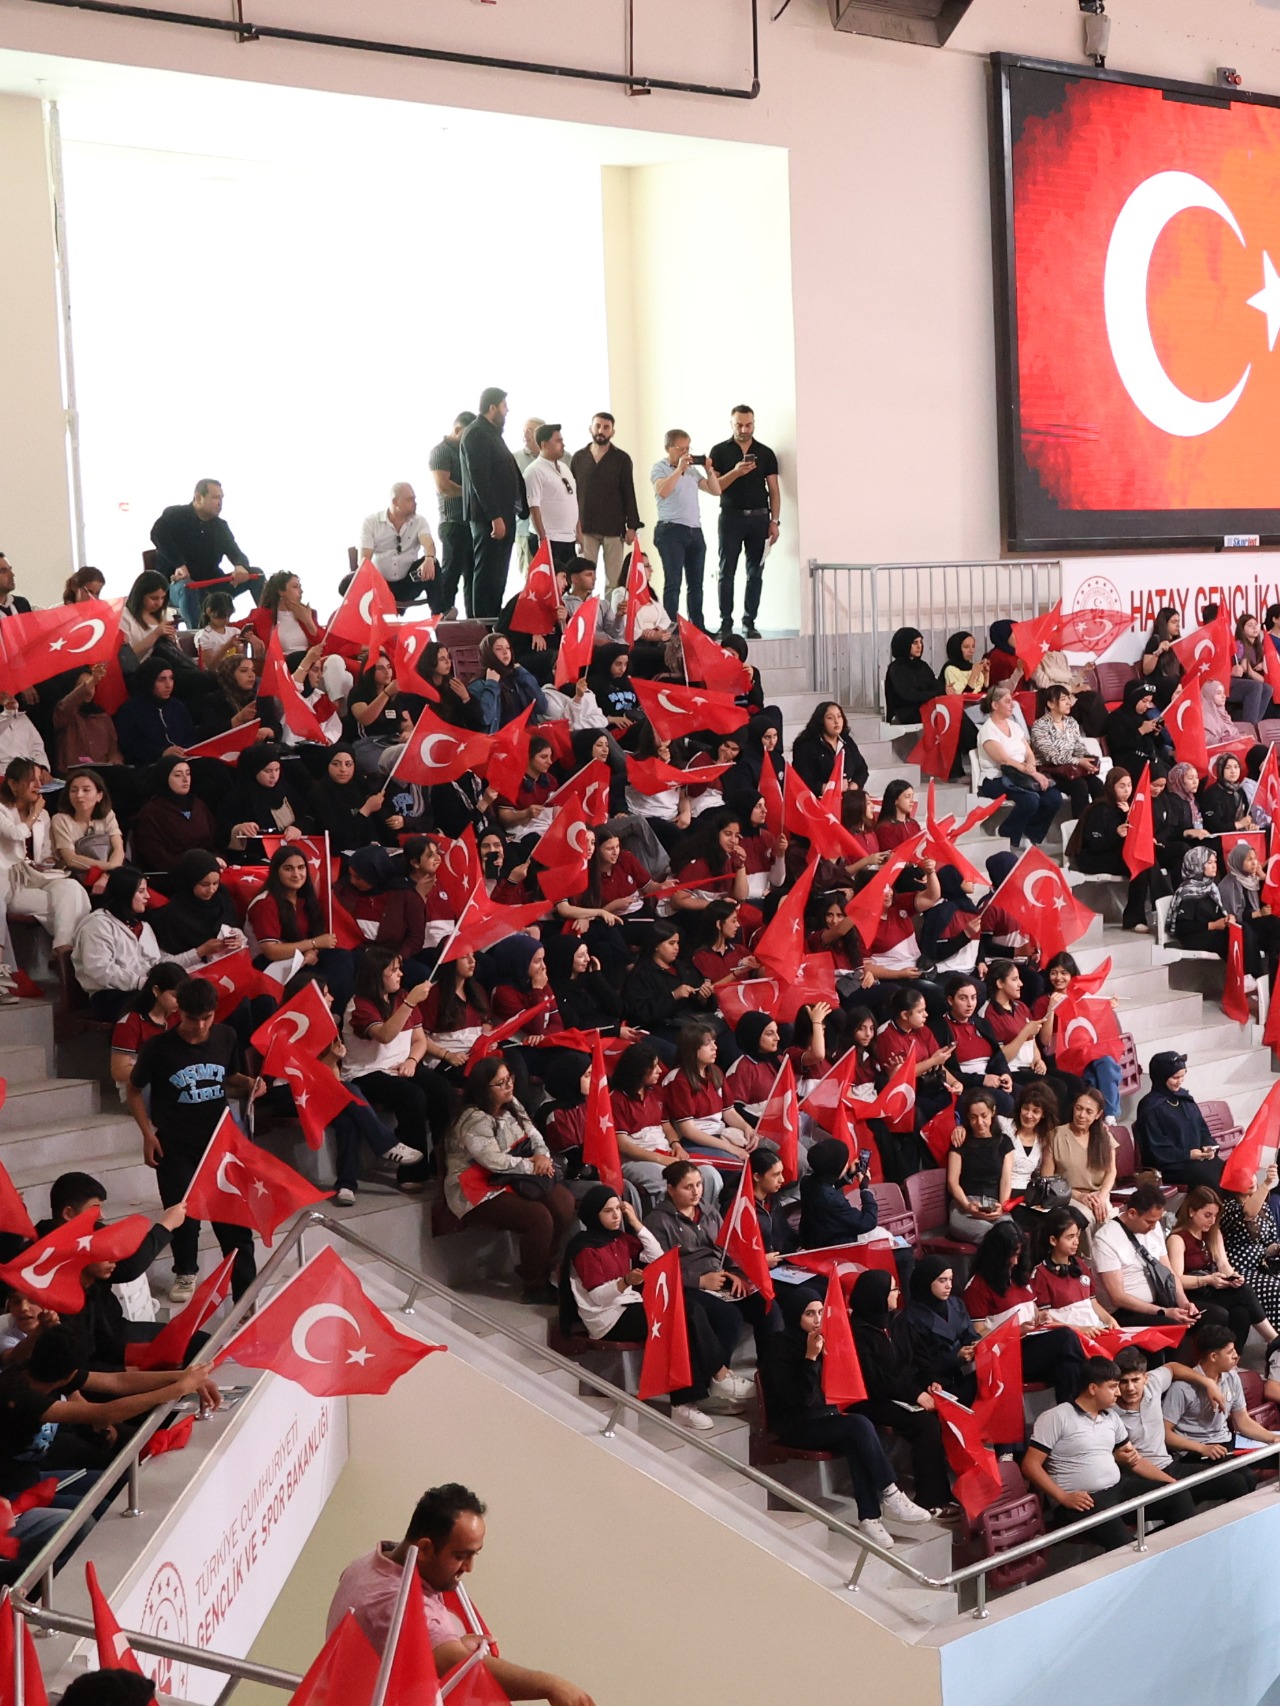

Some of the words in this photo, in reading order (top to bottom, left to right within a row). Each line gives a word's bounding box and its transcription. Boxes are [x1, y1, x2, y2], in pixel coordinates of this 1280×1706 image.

[1131, 588, 1189, 632] HATAY
[196, 1518, 238, 1606] TÜRKİYE
[240, 1413, 298, 1532] CUMHURİYETİ
[197, 1554, 243, 1649] GENÇLİK
[245, 1530, 257, 1573] VE
[261, 1484, 285, 1546] SPOR
[287, 1404, 328, 1501] BAKANLIĞI
